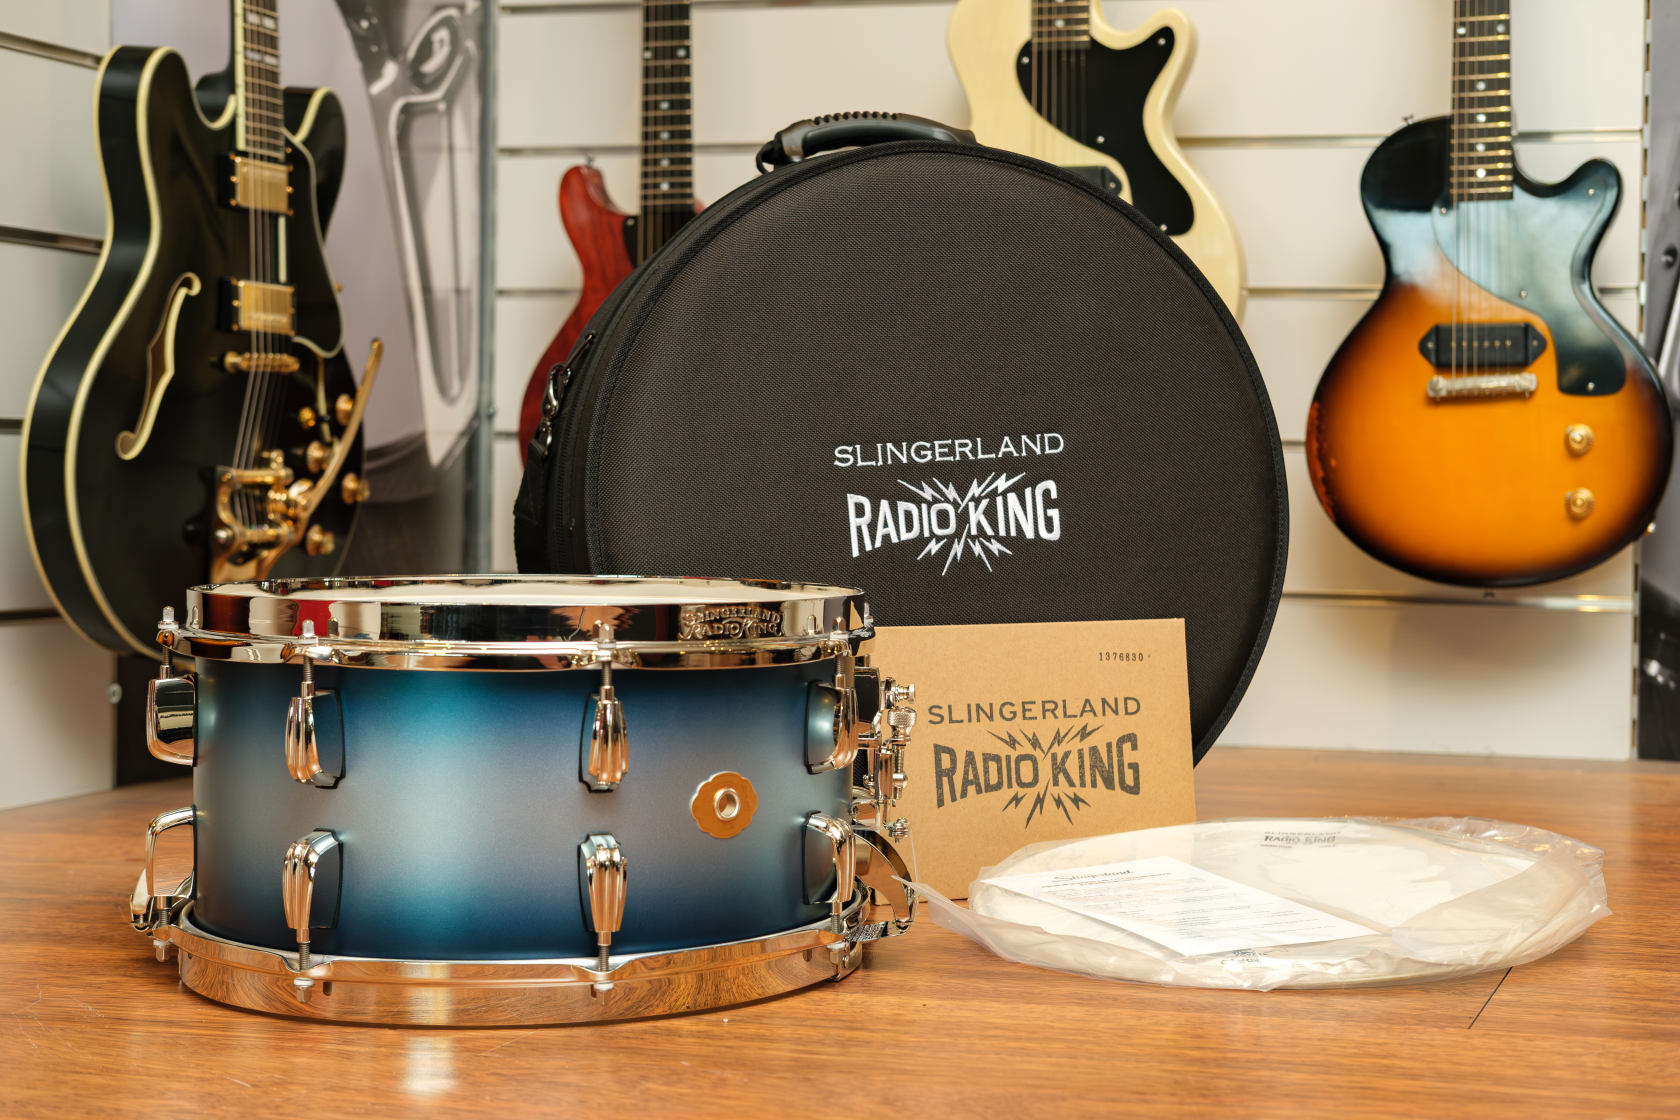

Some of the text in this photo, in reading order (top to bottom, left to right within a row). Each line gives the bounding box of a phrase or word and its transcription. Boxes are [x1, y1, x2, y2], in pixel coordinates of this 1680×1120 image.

[833, 432, 1065, 468] SLINGERLAND
[846, 479, 1062, 558] RADIO KING
[678, 617, 782, 640] RADIO KING
[684, 607, 781, 625] SLINGERLAND
[1099, 651, 1144, 662] 1376830
[927, 696, 1142, 725] SLINGERLAND
[932, 732, 1141, 809] RADIO KING
